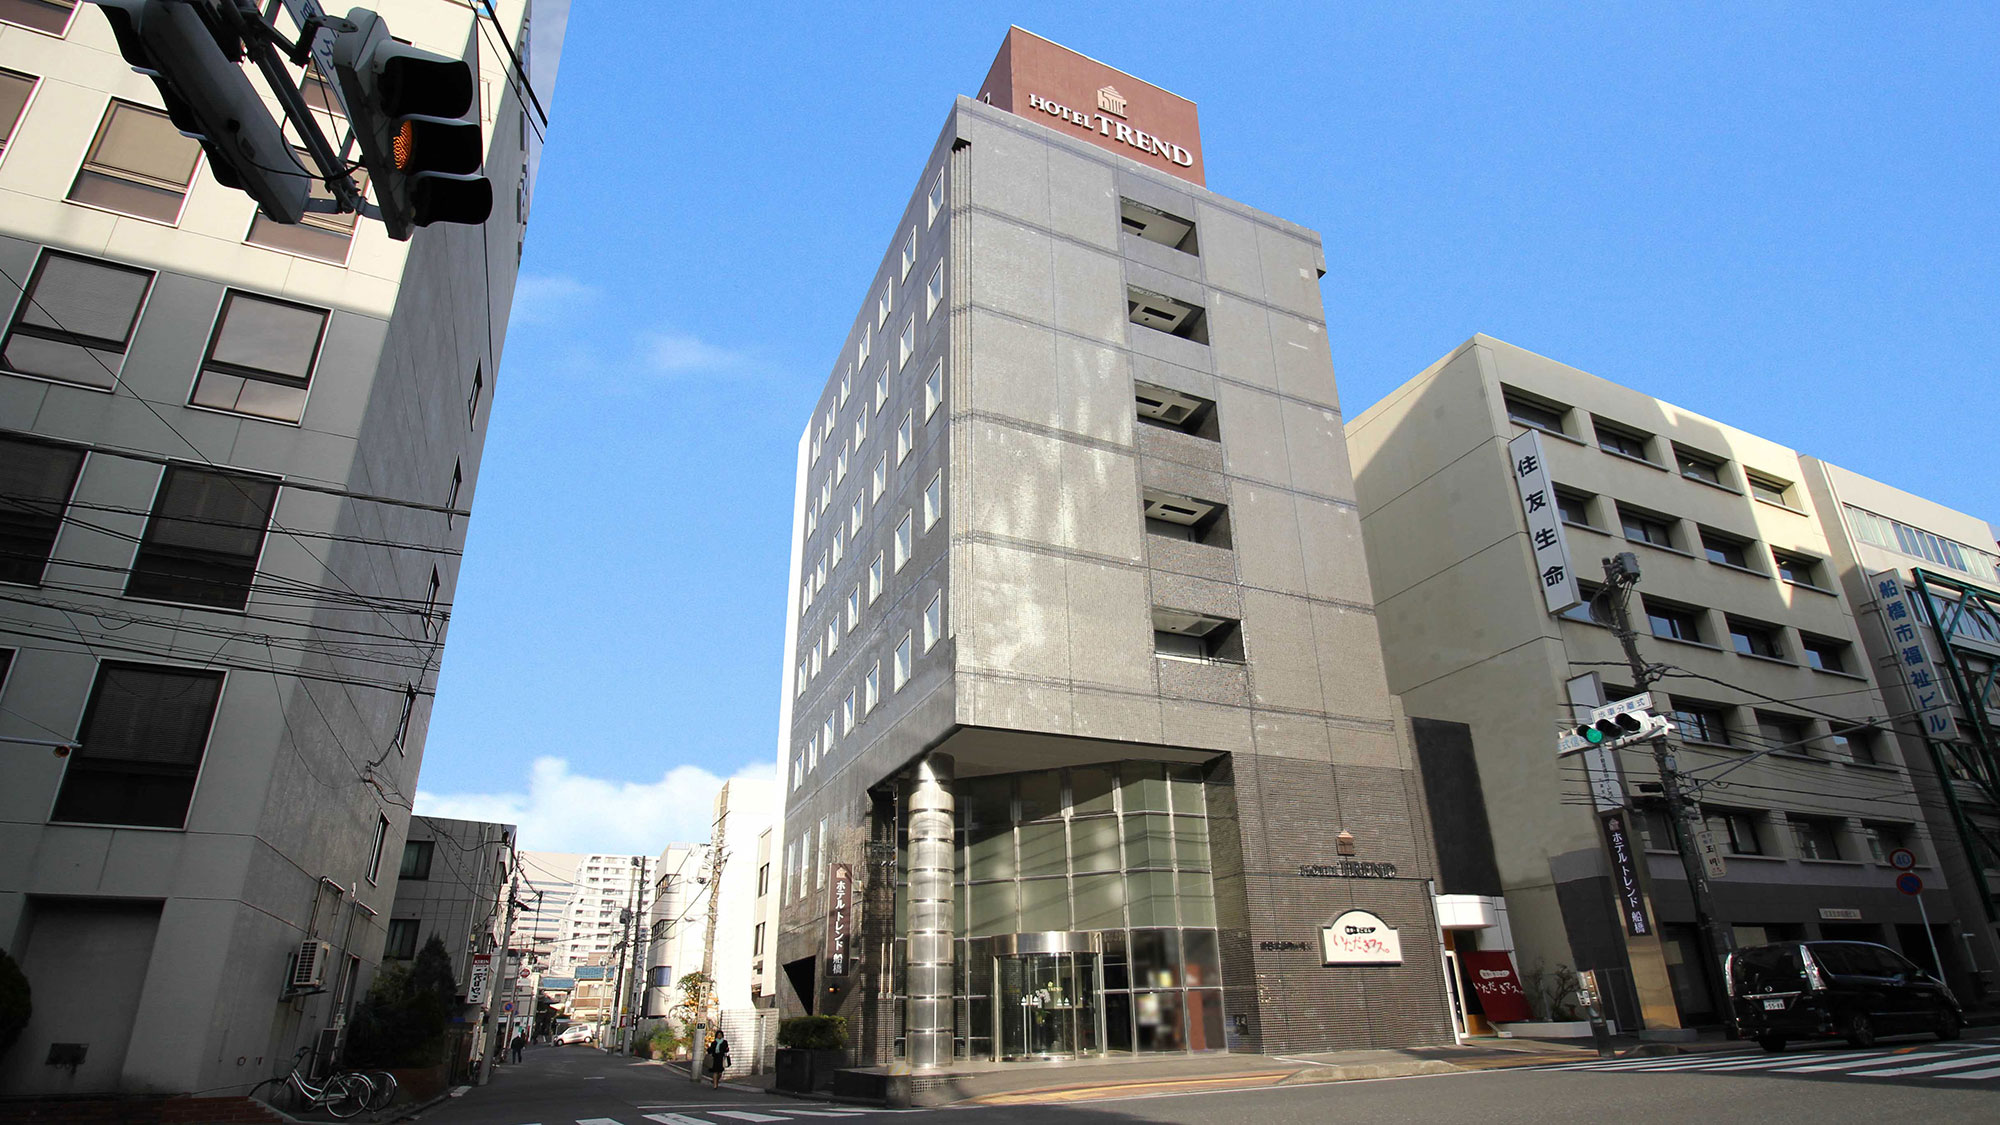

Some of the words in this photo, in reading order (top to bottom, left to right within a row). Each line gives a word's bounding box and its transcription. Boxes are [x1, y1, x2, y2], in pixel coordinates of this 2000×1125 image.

[1029, 94, 1094, 131] HOTEL
[1094, 113, 1193, 168] TREND
[1517, 455, 1564, 587] 住友生命
[1878, 578, 1946, 733] 船橋市福祉ビル
[1622, 866, 1638, 908] トレンド
[1896, 854, 1911, 865] 40
[834, 911, 844, 951] トレンド
